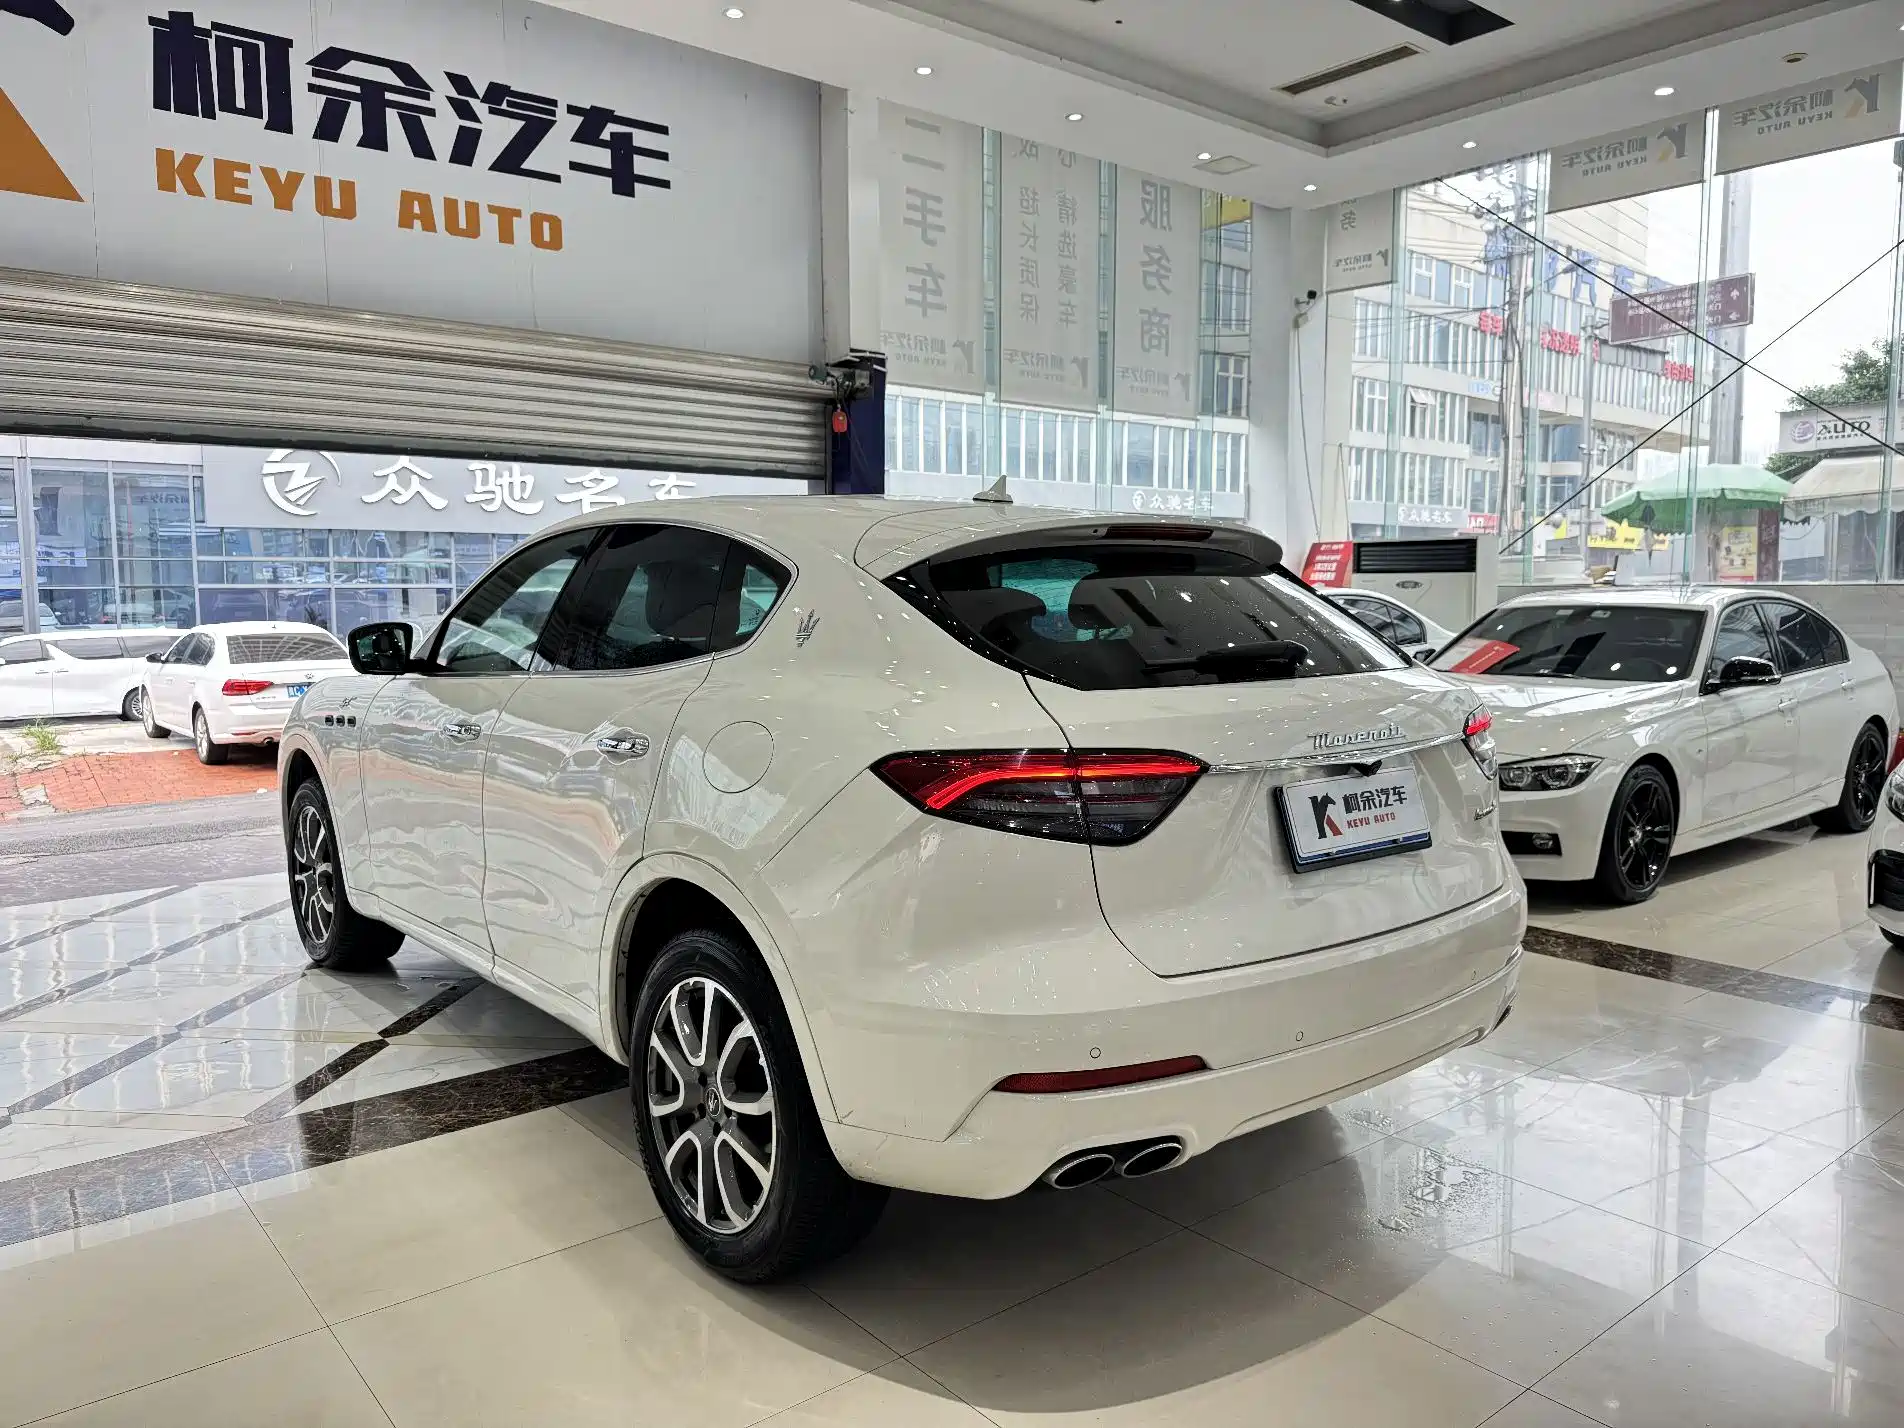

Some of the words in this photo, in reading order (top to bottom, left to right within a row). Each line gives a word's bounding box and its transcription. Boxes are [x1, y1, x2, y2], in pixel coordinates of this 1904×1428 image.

[148, 11, 671, 198] 柯余汽车
[155, 147, 357, 221] KEYU
[398, 190, 564, 252] AUTO
[1342, 785, 1408, 814] 柯余汽车
[1346, 817, 1371, 829] KEYU
[1374, 812, 1396, 824] AUTO
